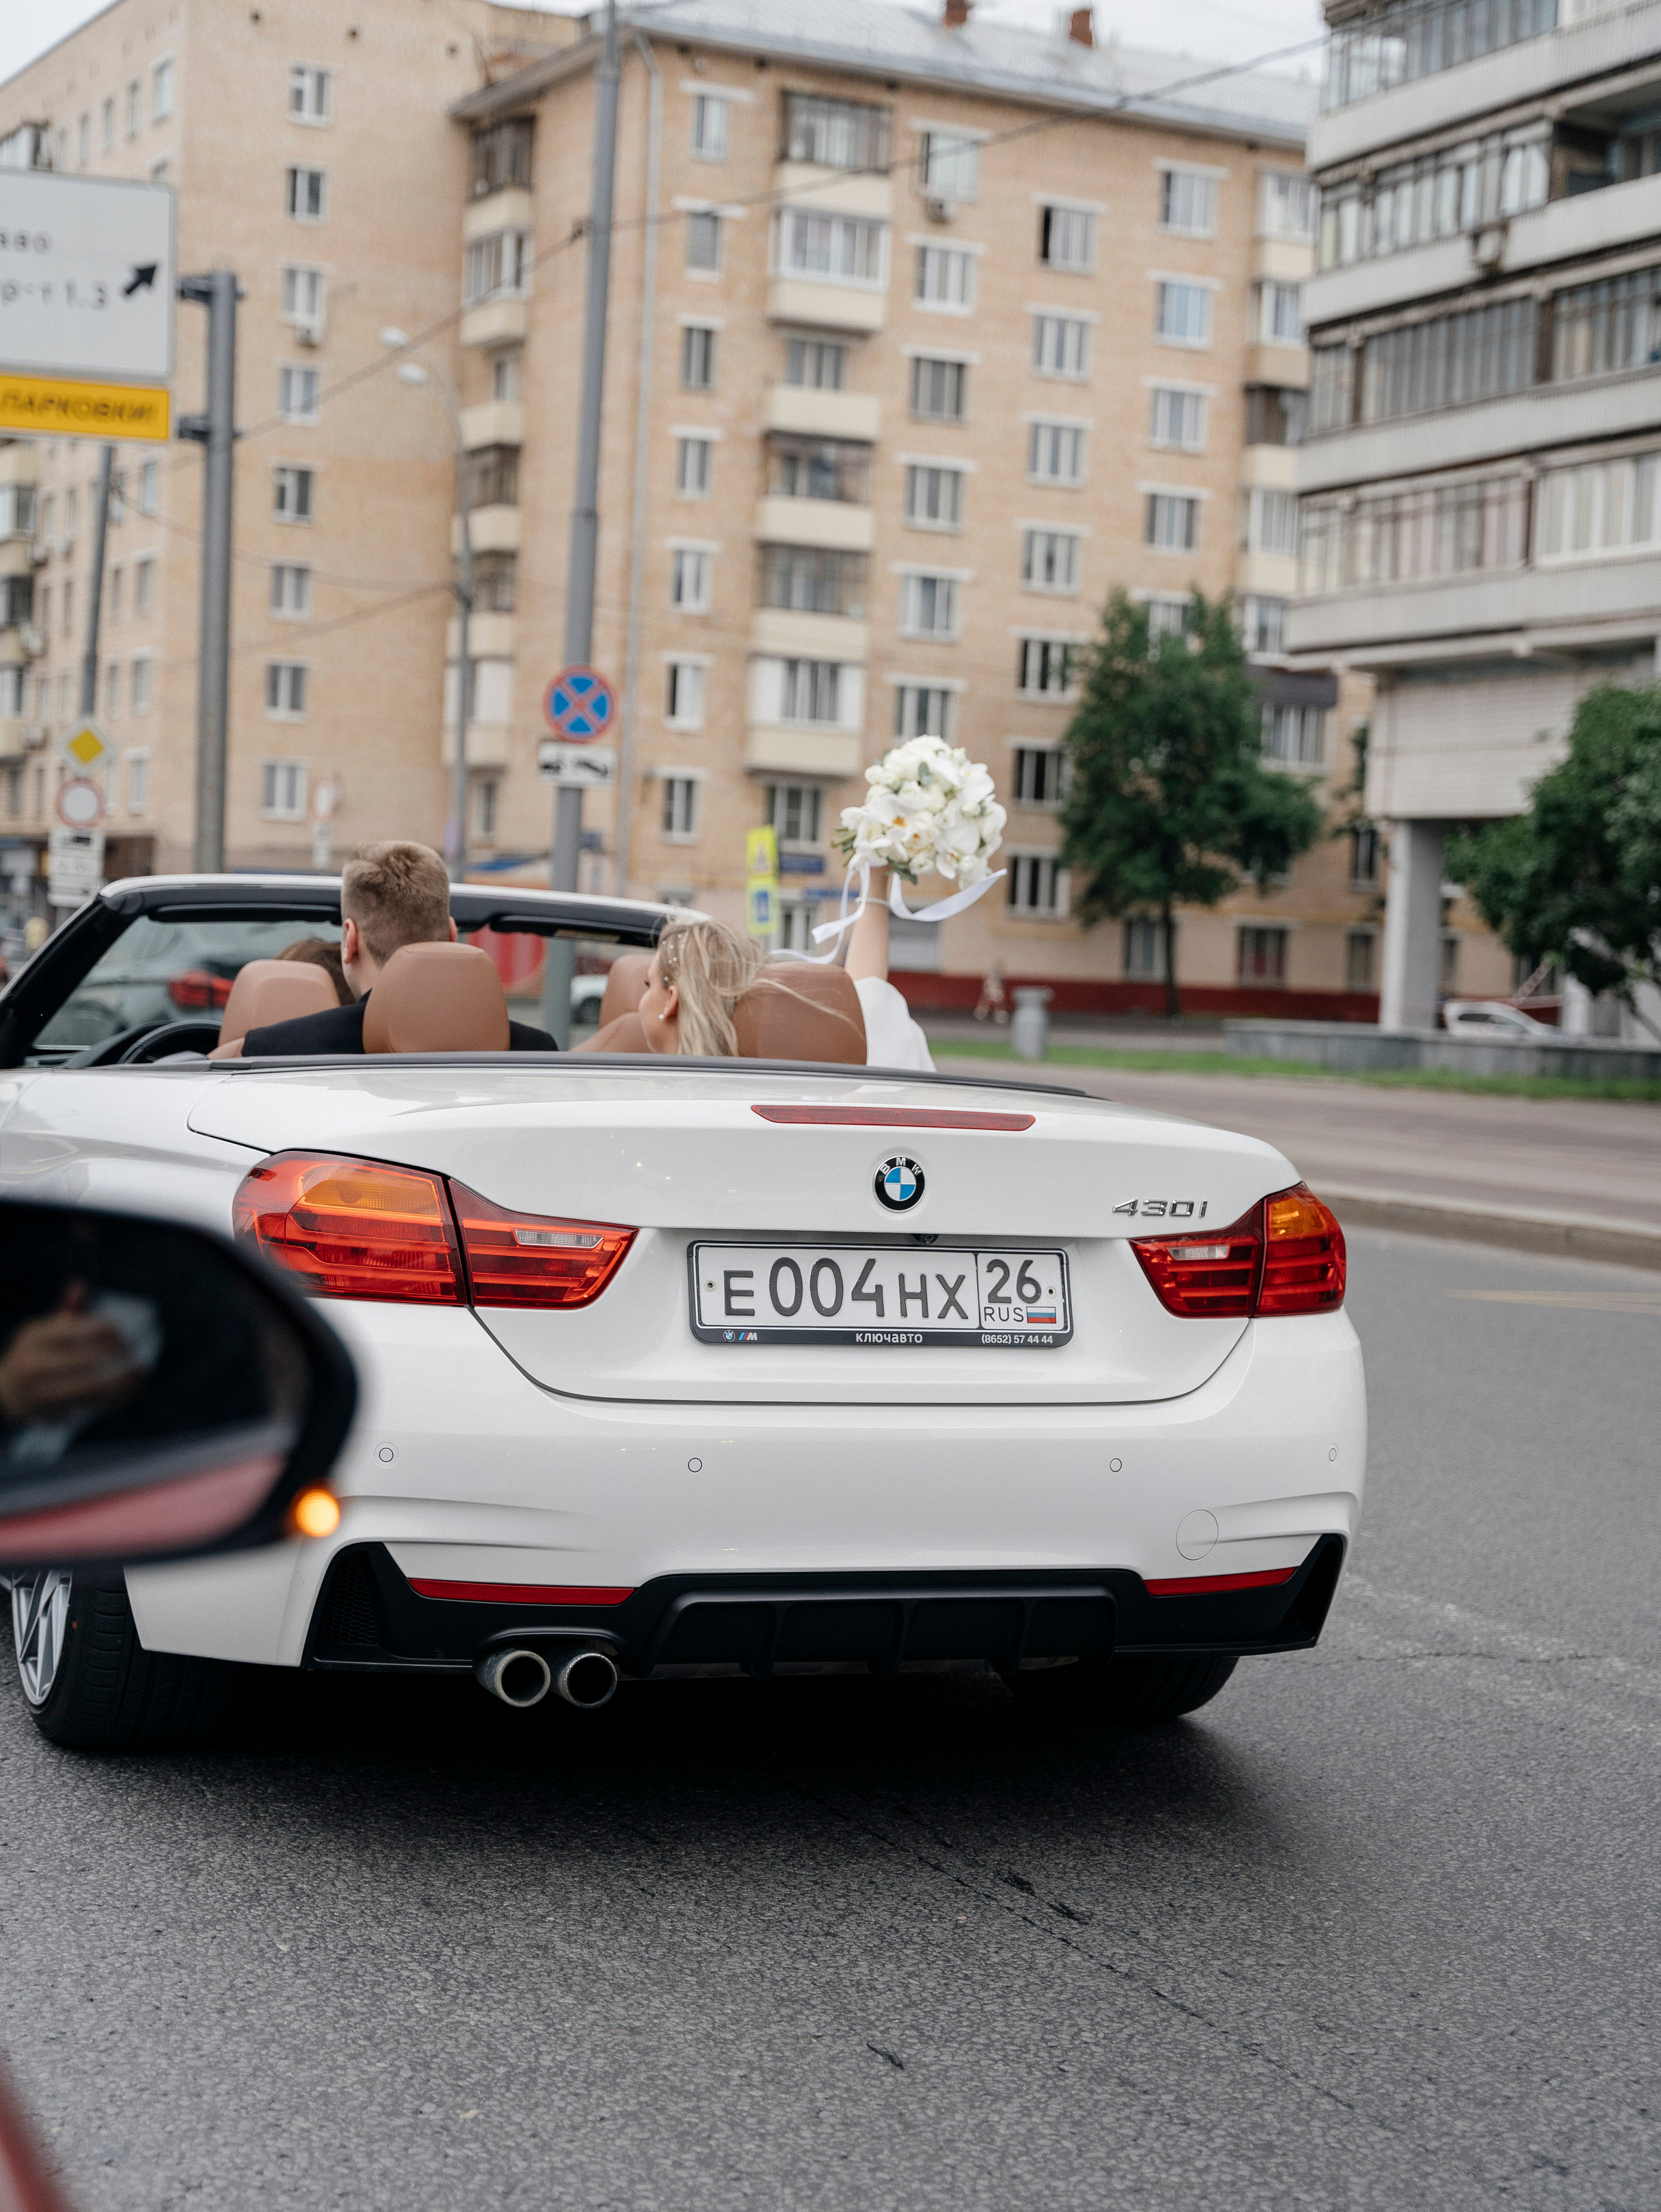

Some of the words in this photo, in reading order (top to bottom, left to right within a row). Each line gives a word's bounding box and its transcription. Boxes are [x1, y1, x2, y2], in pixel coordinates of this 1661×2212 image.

[879, 1157, 922, 1176] BMW
[1112, 1198, 1207, 1218] 430i
[986, 1259, 1041, 1304] 26
[984, 1306, 1024, 1322] RUS
[981, 1334, 1012, 1344] (8652)
[1013, 1335, 1024, 1344] 57
[1027, 1335, 1039, 1344] 44
[1041, 1335, 1053, 1344] 44
